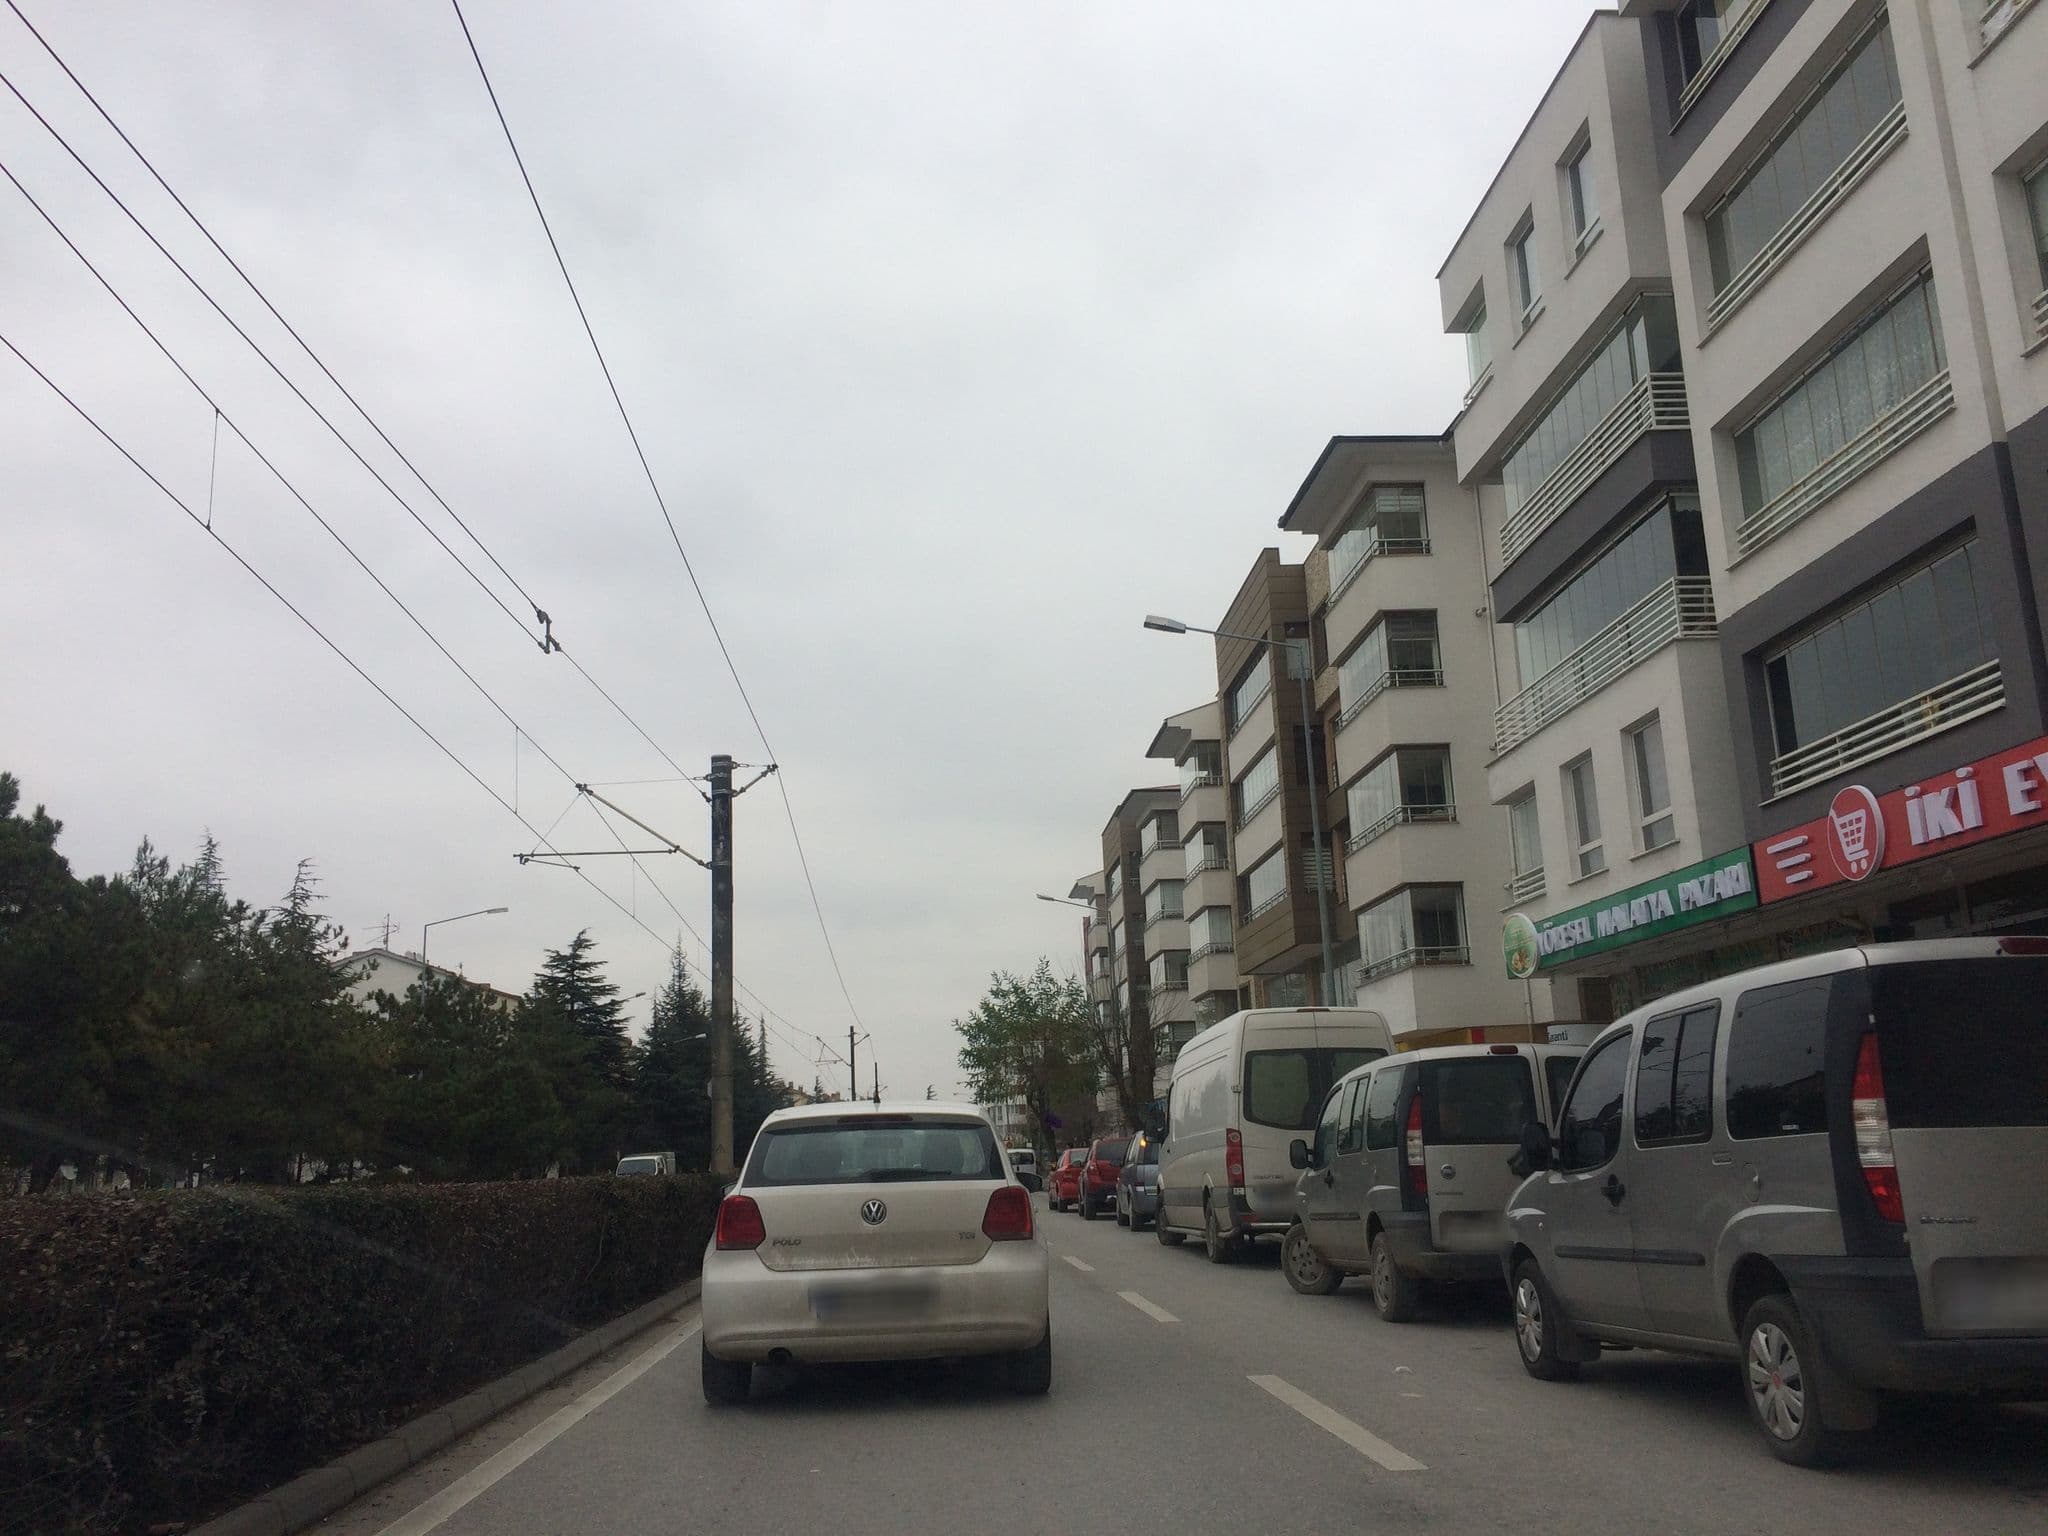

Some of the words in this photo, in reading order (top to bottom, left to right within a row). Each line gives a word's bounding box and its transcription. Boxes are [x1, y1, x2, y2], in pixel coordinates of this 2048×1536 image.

[1904, 767, 1983, 846] İKİ
[1597, 889, 1675, 938] MALATYA
[1678, 862, 1752, 912] PAZARI
[772, 1239, 802, 1247] POLO
